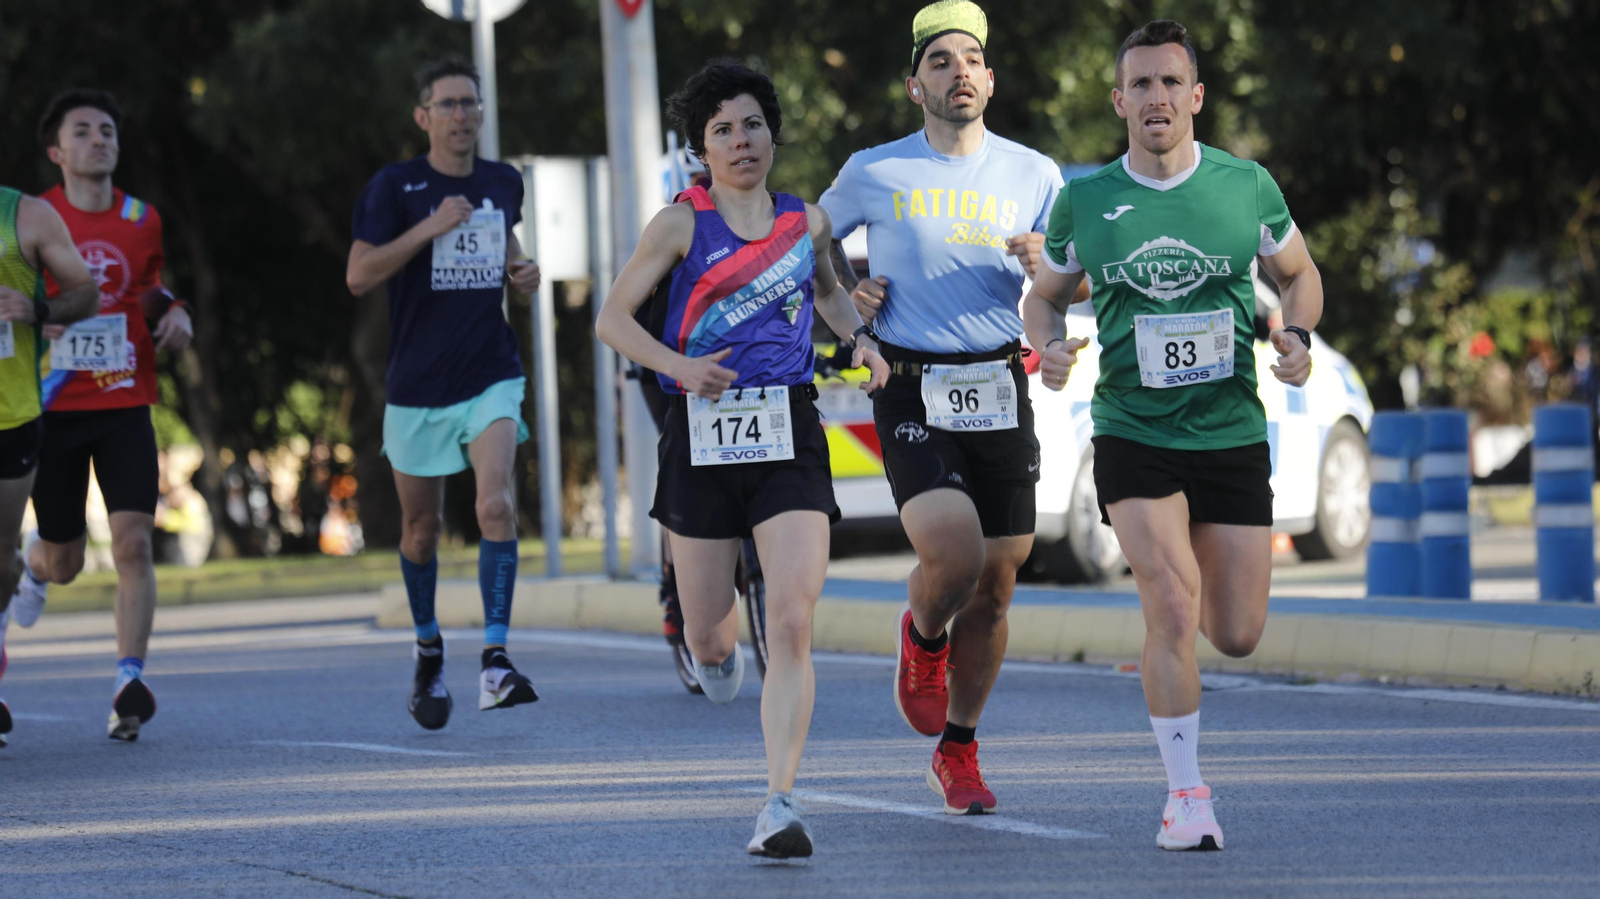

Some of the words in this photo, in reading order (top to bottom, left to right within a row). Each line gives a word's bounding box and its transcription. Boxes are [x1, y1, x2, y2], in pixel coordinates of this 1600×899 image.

[892, 188, 1019, 231] FATIGAS
[455, 232, 478, 254] 45
[1142, 248, 1185, 260] PIZZERÍA
[717, 293, 751, 312] C.A.
[753, 252, 801, 294] JIMENA
[1102, 265, 1129, 282] LA
[1133, 259, 1232, 277] TOSCANA
[724, 275, 797, 328] RUNNERS
[69, 335, 106, 357] 175
[1164, 340, 1197, 370] 83
[1163, 370, 1210, 385] EVOS
[948, 388, 979, 414] 96
[711, 415, 762, 446] 174
[950, 418, 994, 429] EVOS
[719, 449, 768, 461] EVOS
